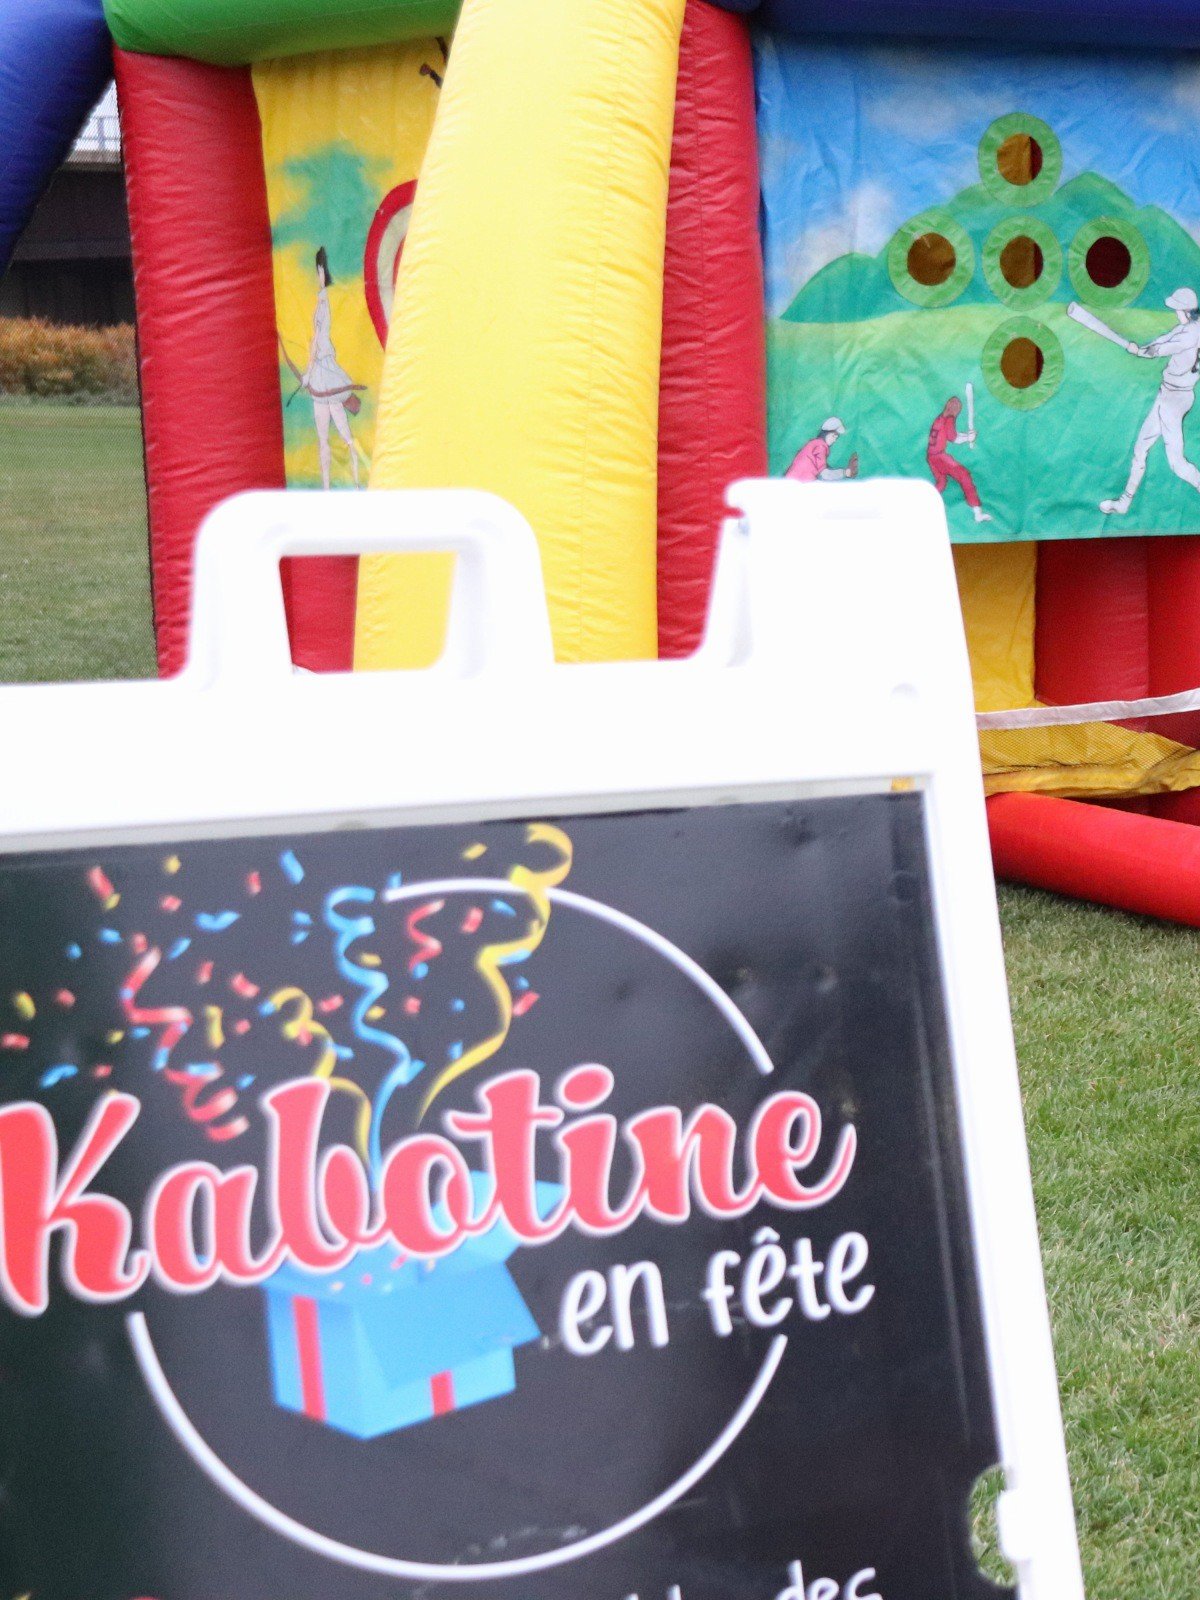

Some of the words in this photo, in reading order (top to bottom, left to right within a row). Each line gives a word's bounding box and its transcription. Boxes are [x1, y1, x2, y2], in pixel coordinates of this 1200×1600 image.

[0, 1063, 858, 1317] Kabotine
[560, 1260, 669, 1357] en
[702, 1225, 876, 1337] fête
